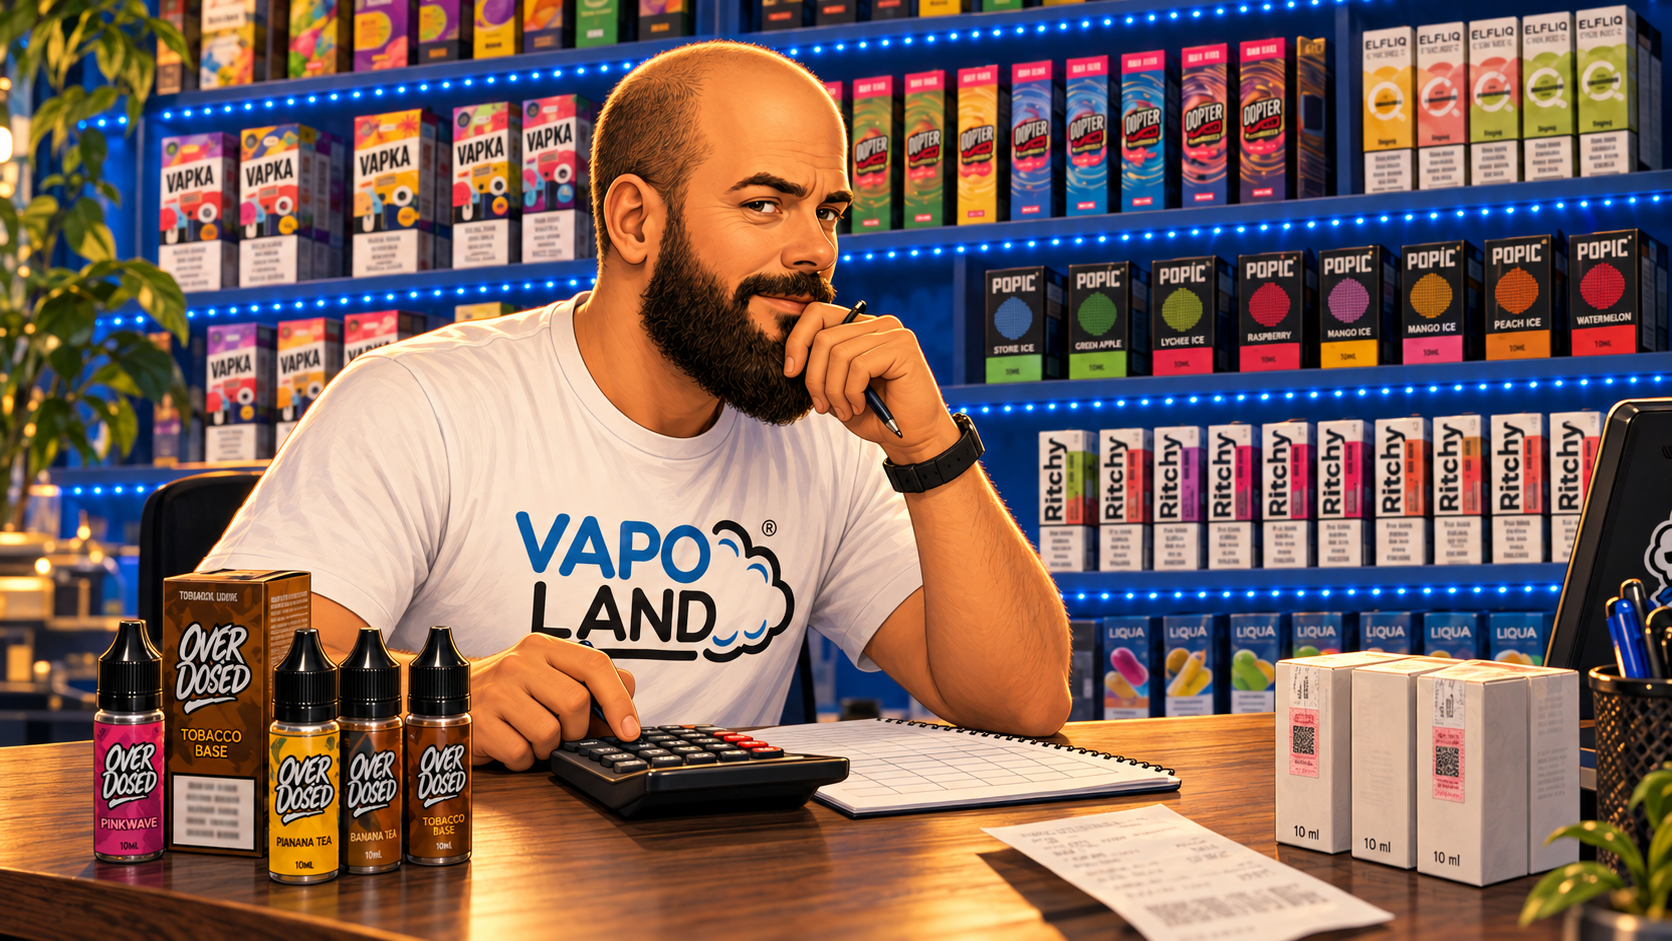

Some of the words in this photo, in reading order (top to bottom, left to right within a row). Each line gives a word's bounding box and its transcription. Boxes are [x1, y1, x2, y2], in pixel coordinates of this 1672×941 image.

[1525, 22, 1568, 35] ELFLIQ
[1579, 15, 1623, 29] ELFLIQ
[1420, 32, 1461, 45] ELFLIQ
[1471, 26, 1514, 40] ELFLIQ
[1365, 37, 1406, 50] ELFLIQ
[527, 122, 572, 152] VAPKA
[457, 135, 504, 166] VAPKA
[360, 145, 411, 177] VAPKA
[166, 165, 214, 193] VAPKA
[246, 158, 293, 188] VAPKA
[1492, 244, 1541, 265] POPIC
[1577, 238, 1628, 261] POPIC
[1247, 259, 1294, 279] POPIC
[1324, 254, 1372, 275] POPIC
[992, 274, 1035, 294] POPIC
[1077, 270, 1120, 289] POPIC
[1408, 324, 1440, 334] MANGO
[1442, 322, 1456, 331] ICE
[1495, 319, 1524, 329] PEACH
[1526, 318, 1541, 327] ICE
[1577, 312, 1632, 325] WATERMELON
[1191, 336, 1205, 344] ICE
[1247, 331, 1292, 342] RASPBERRY
[1328, 329, 1357, 337] MANGO
[1358, 327, 1371, 336] ICE
[1021, 344, 1034, 353] ICE
[1075, 341, 1098, 350] GREEN
[1099, 340, 1122, 349] APPLE
[211, 354, 252, 379] VAPKA
[280, 349, 321, 374] VAPKA
[1213, 432, 1237, 517] Ritchy
[1267, 430, 1292, 516] Ritchy
[1321, 428, 1346, 515] Ritchy
[1380, 425, 1406, 514] Ritchy
[1437, 423, 1464, 512] Ritchy
[1497, 421, 1524, 510] Ritchy
[1556, 420, 1585, 510] Ritchy
[1043, 437, 1067, 521] Ritchy
[1104, 436, 1128, 520] Ritchy
[1159, 434, 1183, 518] Ritchy
[515, 511, 711, 584] VAPO
[531, 581, 717, 643] LAND
[1109, 627, 1145, 639] LIQUA
[1169, 626, 1207, 640] LIQUA
[1237, 626, 1276, 639] LIQUA
[1297, 626, 1336, 639] LIQUA
[1366, 626, 1405, 639] LIQUA
[1431, 626, 1471, 640] LIQUA
[1497, 627, 1537, 639] LIQUA
[179, 622, 248, 665] OVER
[176, 660, 251, 701] DOSED
[180, 728, 242, 743] TOBACCO
[105, 743, 156, 773] OVER
[195, 745, 228, 758] BASE
[420, 744, 465, 773] OVER
[279, 755, 332, 787] OVER
[349, 751, 396, 783] OVER
[102, 769, 158, 800] DOSED
[347, 778, 397, 808] DOSED
[418, 770, 467, 800] DOSED
[275, 782, 334, 815] DOSED
[101, 817, 158, 830] PINKWAVE
[423, 814, 465, 826] TOBACCO
[316, 836, 332, 846] TEA
[350, 830, 384, 842] BANANA
[385, 829, 397, 839] TEA
[433, 826, 455, 836] BASE
[1293, 825, 1306, 838] 10
[1308, 828, 1320, 841] ml
[1363, 837, 1377, 851] 10
[1379, 840, 1391, 853] ml
[1433, 851, 1446, 864] 10
[1448, 853, 1460, 867] ml
